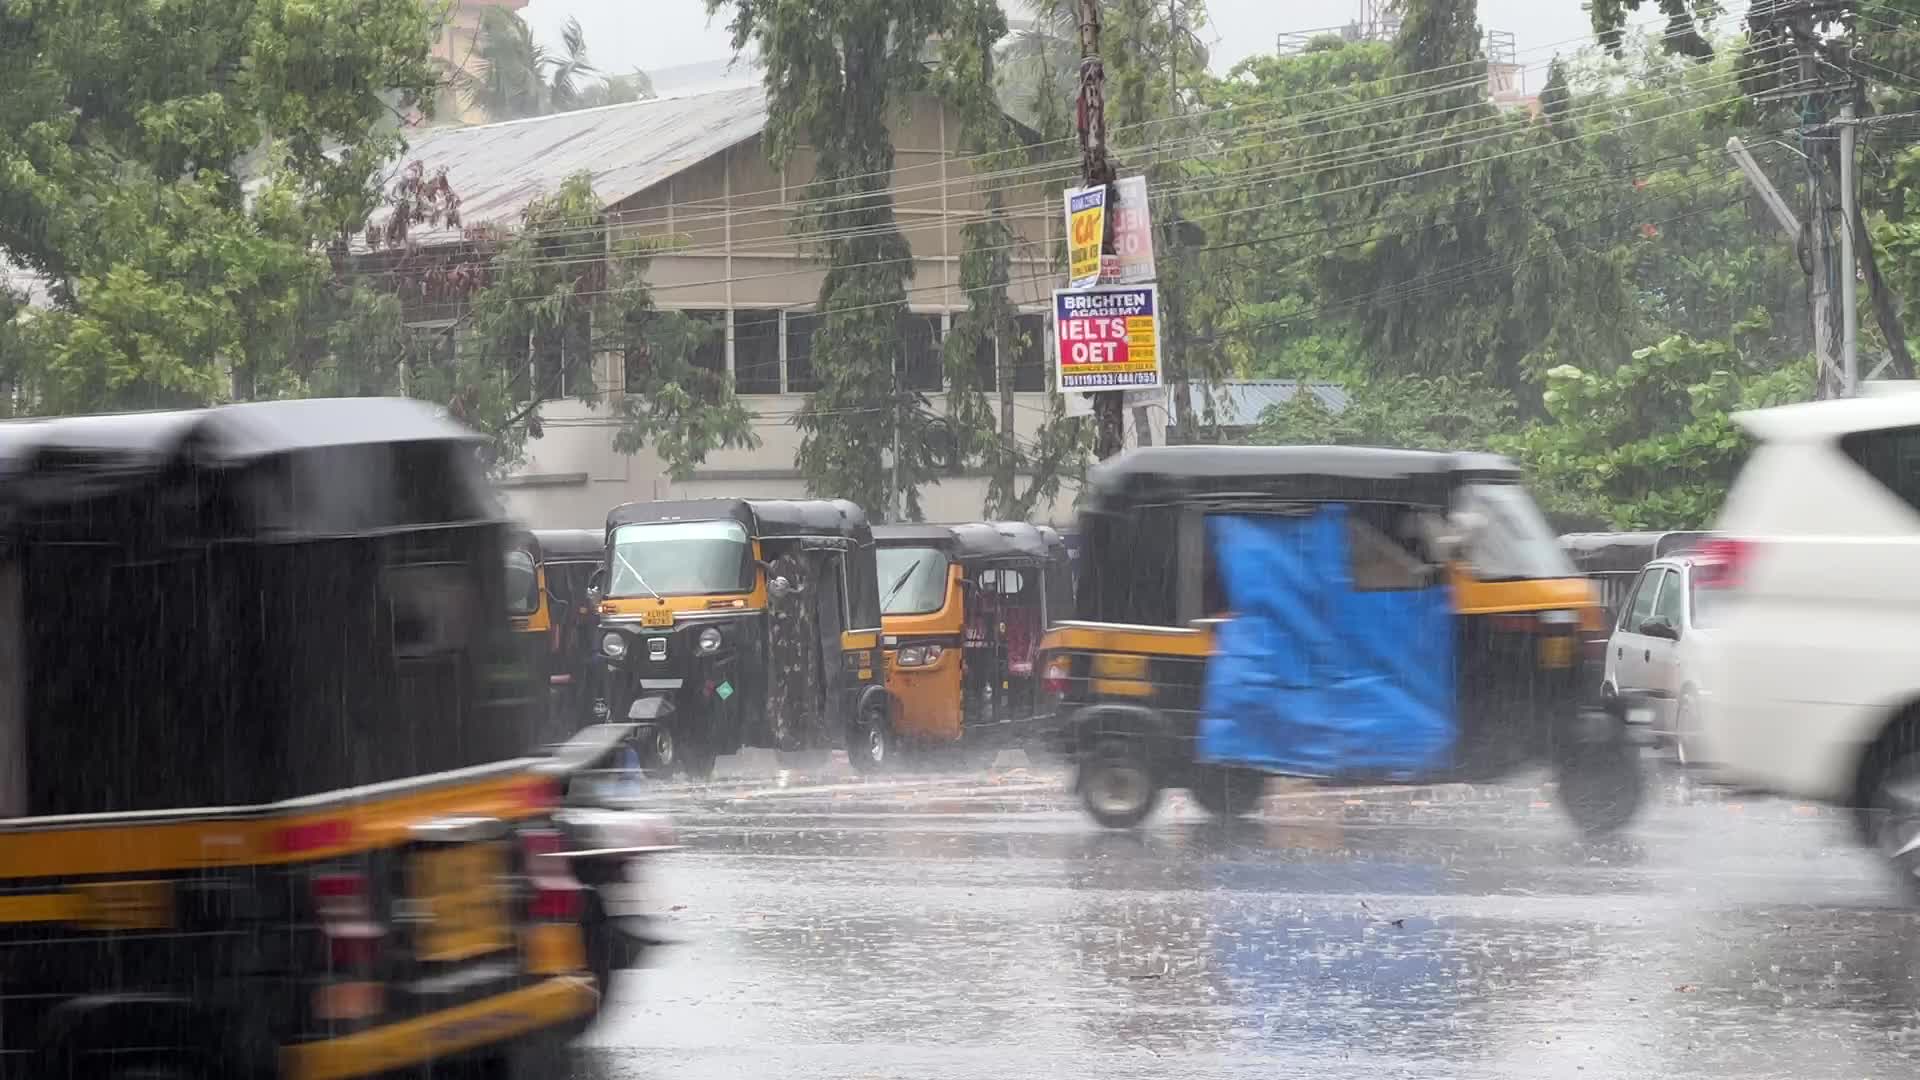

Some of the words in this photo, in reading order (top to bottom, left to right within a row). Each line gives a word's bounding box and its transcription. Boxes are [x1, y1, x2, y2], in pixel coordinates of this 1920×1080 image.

[1064, 293, 1145, 309] BRIGHTEN
[1070, 307, 1141, 317] ACADEMY
[1061, 318, 1126, 340] IELTS
[1071, 342, 1117, 363] OET
